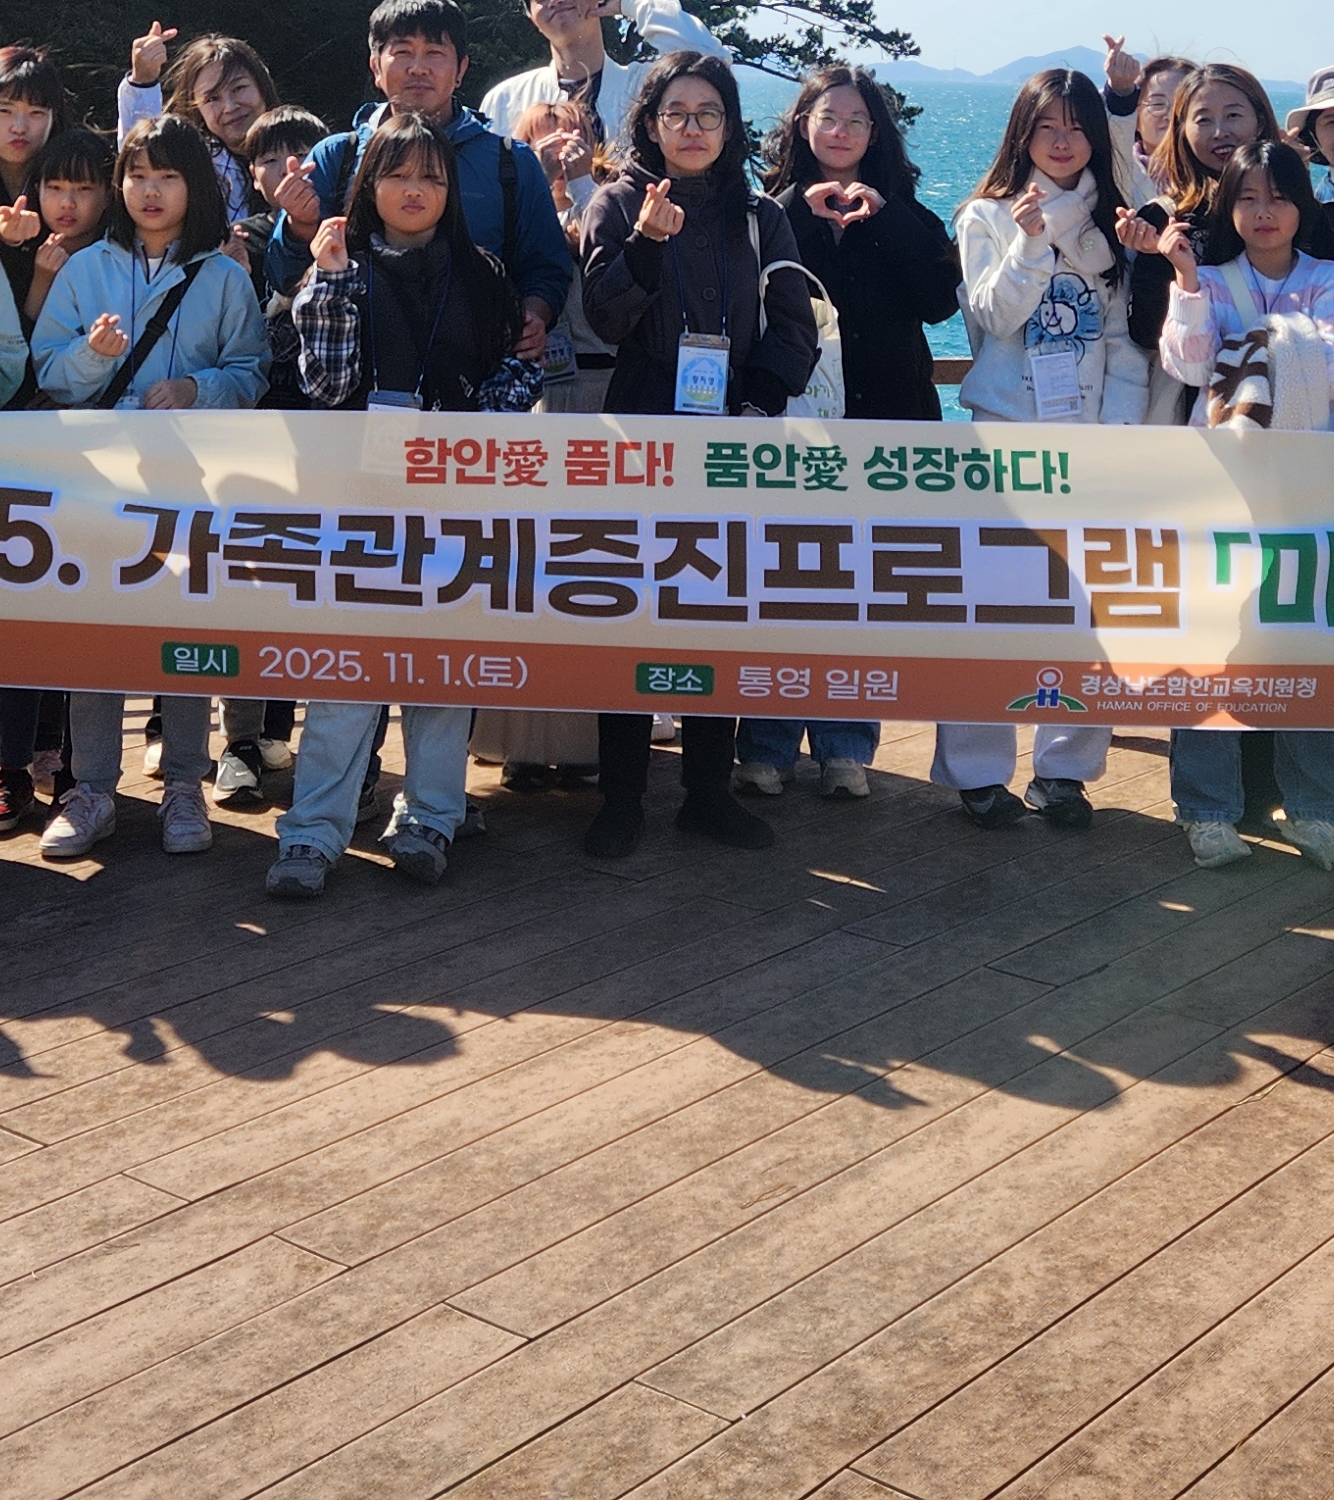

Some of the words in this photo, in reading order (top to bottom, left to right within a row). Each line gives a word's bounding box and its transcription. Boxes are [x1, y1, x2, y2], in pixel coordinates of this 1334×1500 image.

[404, 437, 549, 487] 함안愛
[565, 440, 675, 488] 품다!
[704, 443, 849, 492] 품안愛
[864, 446, 1072, 494] 성장하다!
[119, 503, 1178, 628] 가족관계증진프로그램
[173, 648, 228, 674] 일시
[258, 646, 371, 682] 2025.
[383, 652, 425, 684] 11.
[648, 667, 703, 692] 장소
[737, 666, 811, 698] 통영
[826, 669, 899, 700] 일원
[1080, 675, 1318, 699] 경상남도함안교육지원청
[1096, 700, 1143, 711] HAMAN
[1147, 701, 1192, 712] OFFICE
[1195, 702, 1213, 712] OF
[1217, 702, 1288, 713] EDUCATION
